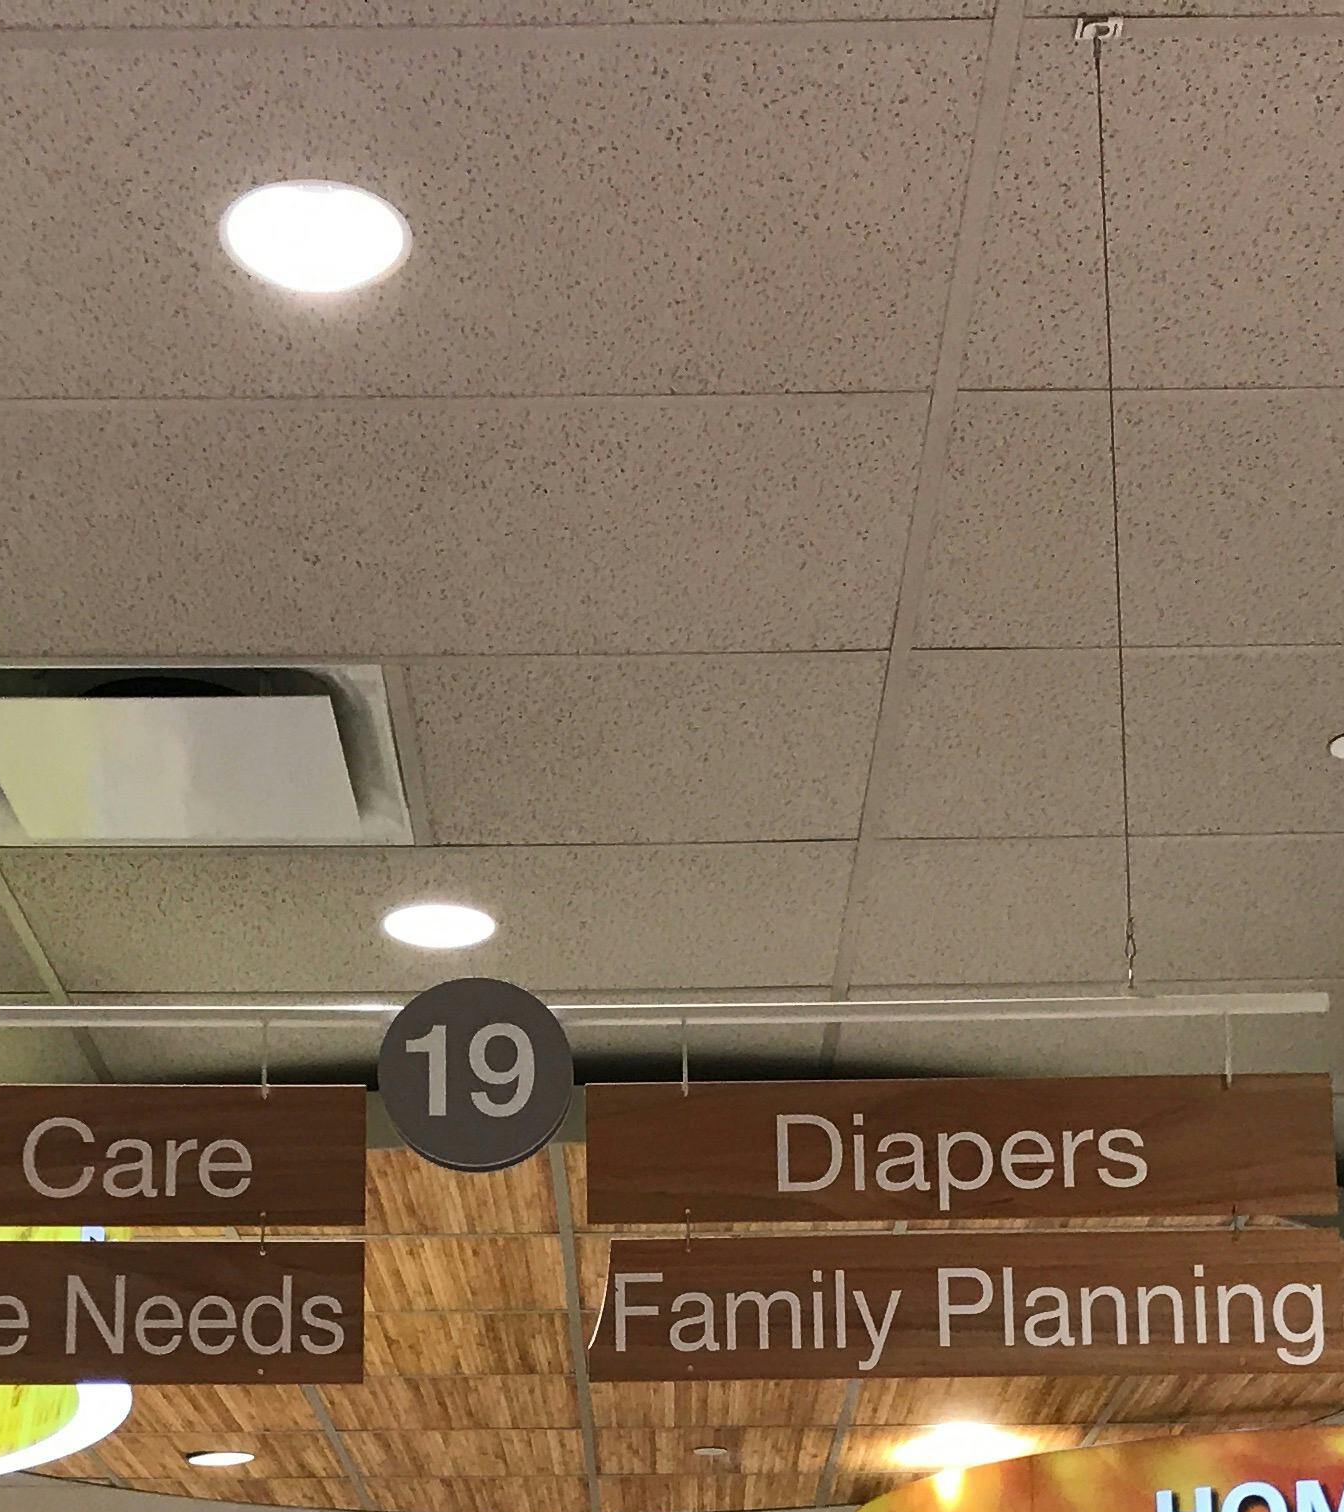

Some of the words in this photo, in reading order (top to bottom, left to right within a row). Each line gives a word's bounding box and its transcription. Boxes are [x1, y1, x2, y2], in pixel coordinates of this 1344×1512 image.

[404, 1022, 535, 1118] 19
[21, 1118, 253, 1199] Care
[774, 1112, 1148, 1211] Diapers
[65, 1275, 346, 1356] Needs
[611, 1269, 902, 1370] Family
[937, 1264, 1325, 1365] Planning
